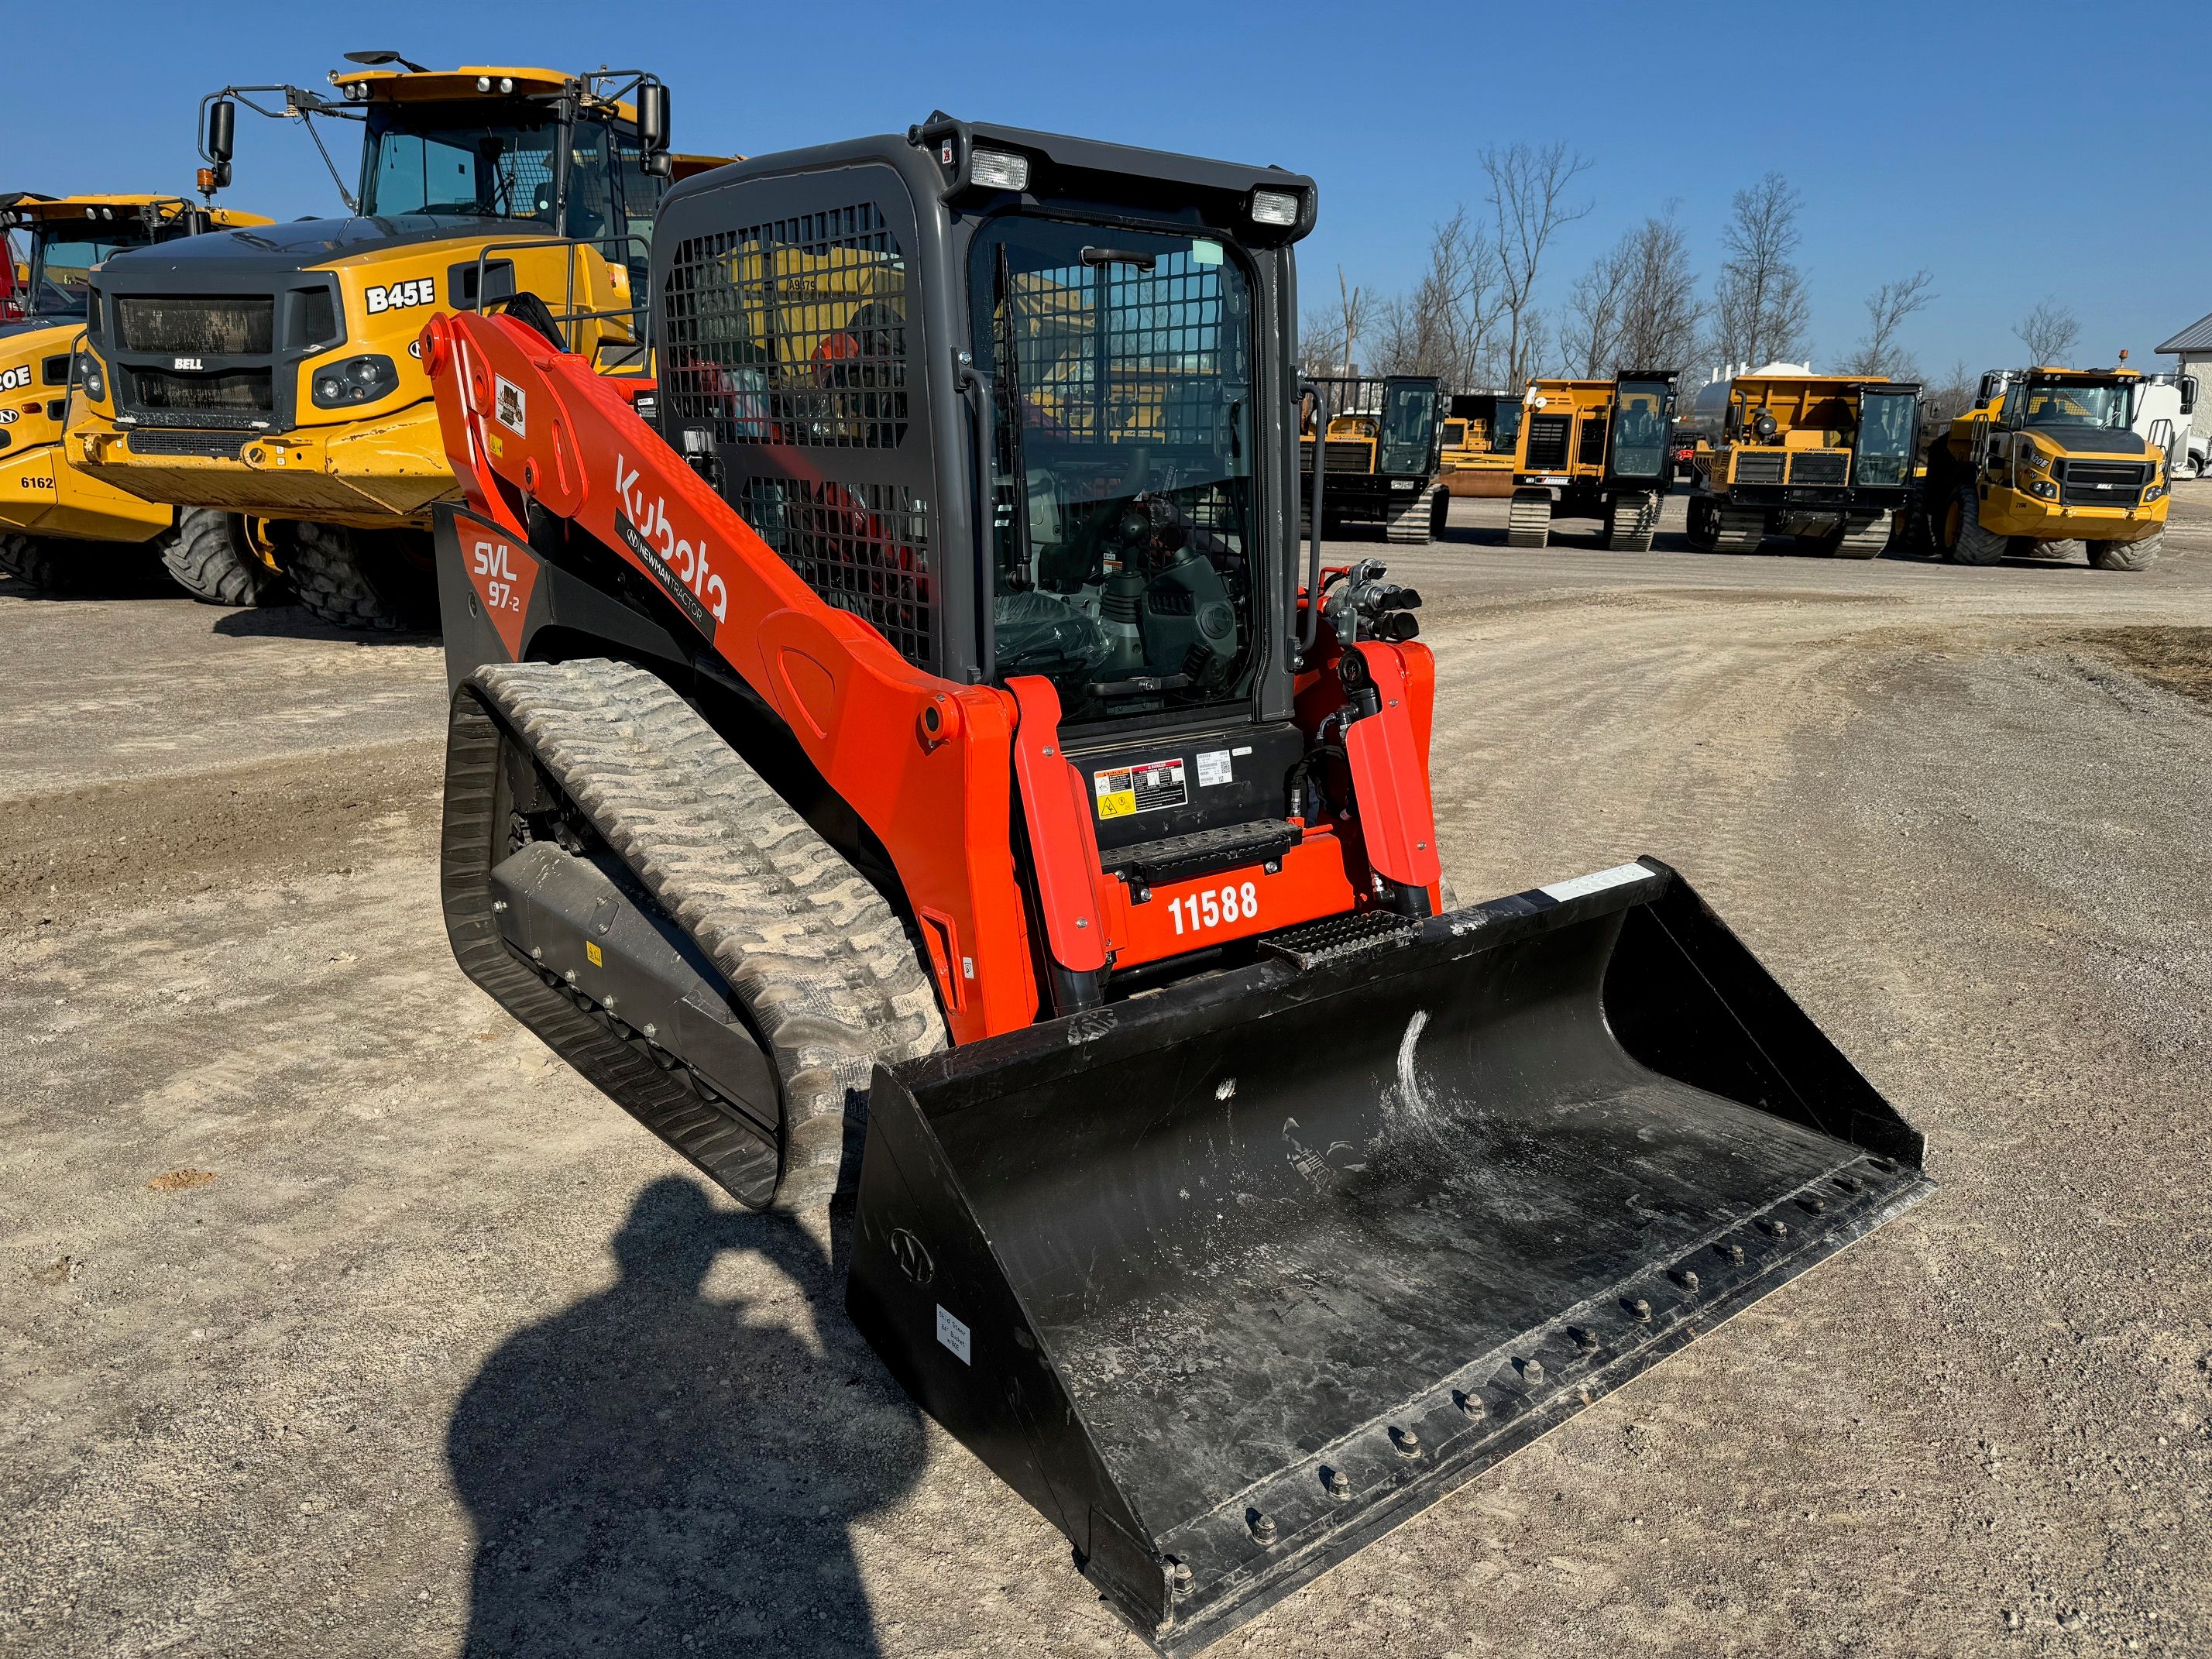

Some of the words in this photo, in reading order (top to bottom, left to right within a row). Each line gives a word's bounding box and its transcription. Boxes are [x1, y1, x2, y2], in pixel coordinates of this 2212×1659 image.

[366, 278, 434, 314] B45E
[0, 366, 31, 392] 0E
[174, 358, 203, 370] BELL
[21, 477, 54, 489] 6162
[615, 452, 727, 625] Kubota
[474, 541, 517, 581] SVL
[1167, 881, 1258, 936] 11588
[939, 1311, 950, 1324] Skid
[952, 1321, 966, 1336] Steer
